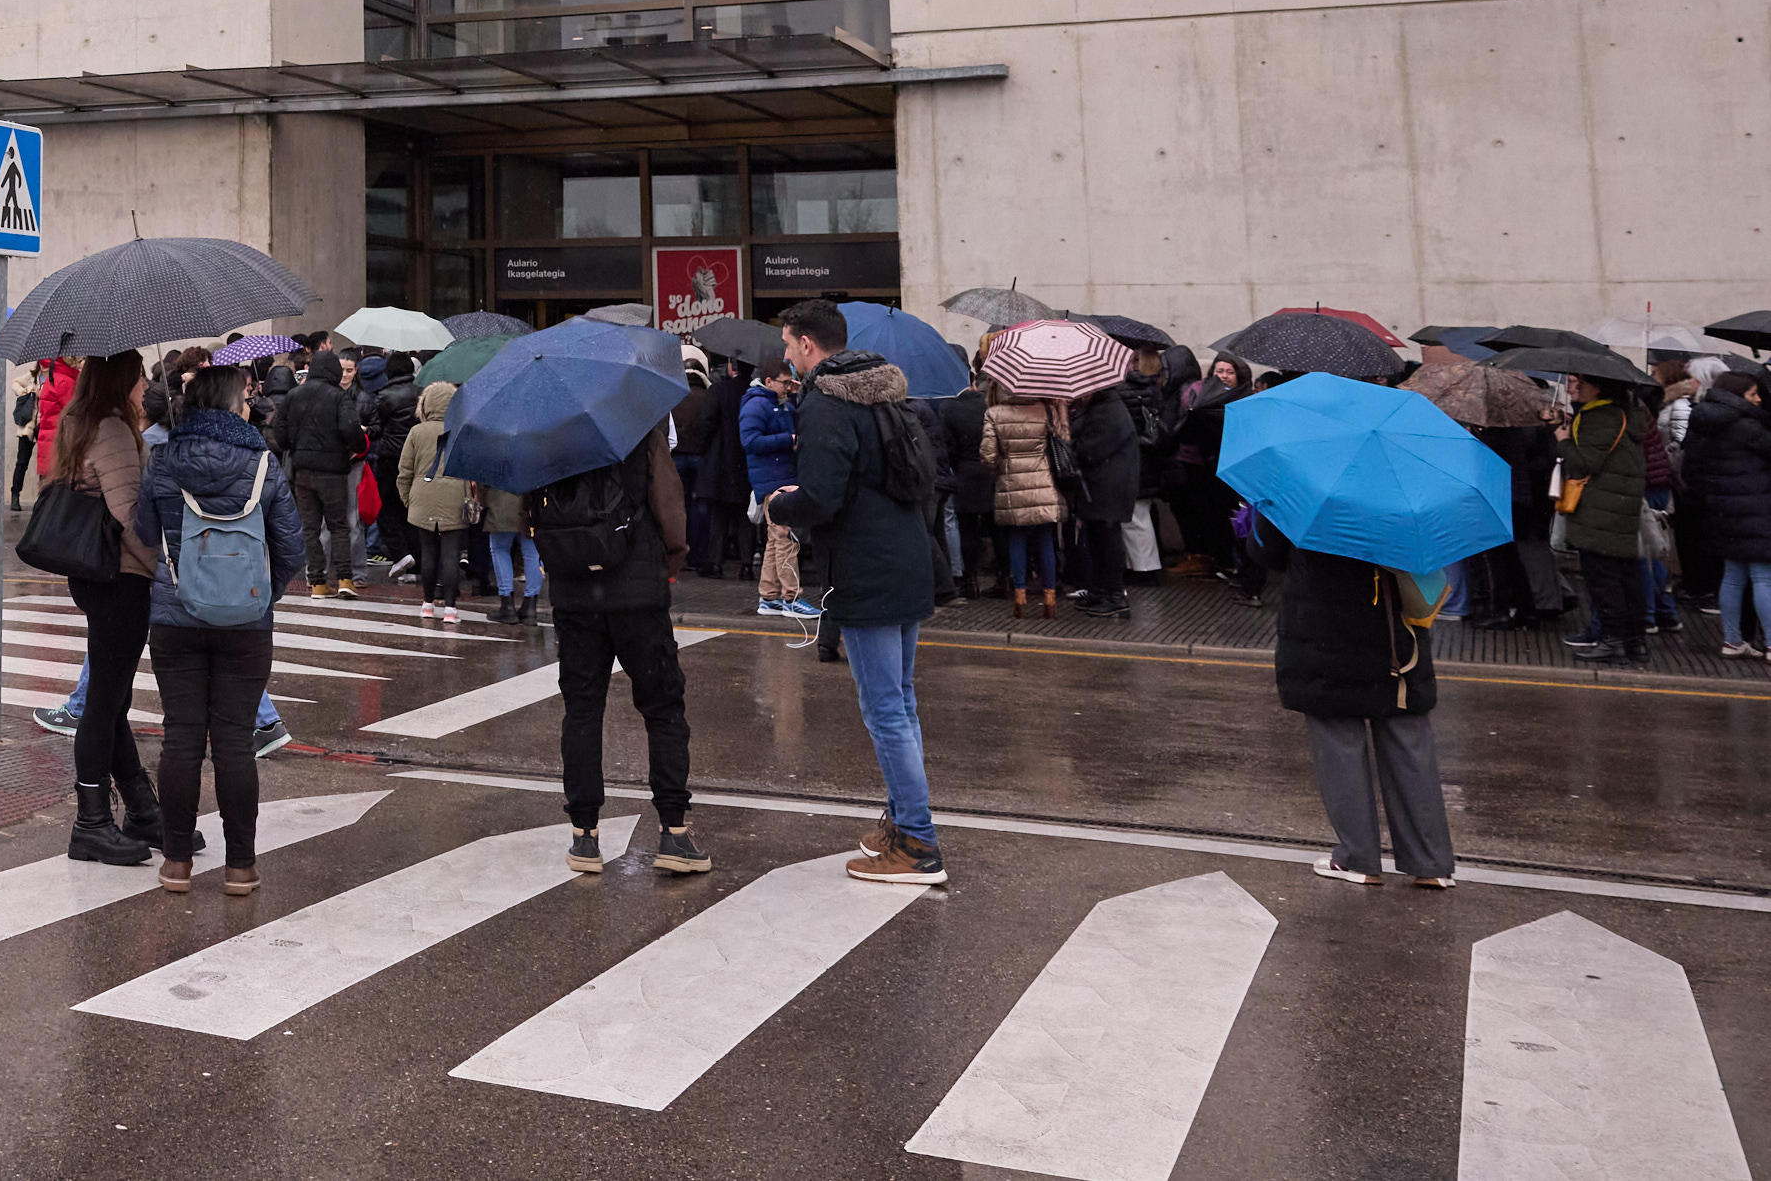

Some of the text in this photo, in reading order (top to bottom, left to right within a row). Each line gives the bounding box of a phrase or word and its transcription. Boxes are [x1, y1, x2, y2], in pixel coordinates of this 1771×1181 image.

[507, 259, 538, 267] Aulario
[765, 256, 799, 265] Aulario
[507, 269, 566, 279] Ikasgelategia
[765, 267, 830, 277] Ikasgelategia
[668, 294, 683, 309] yo
[677, 294, 724, 318] dono
